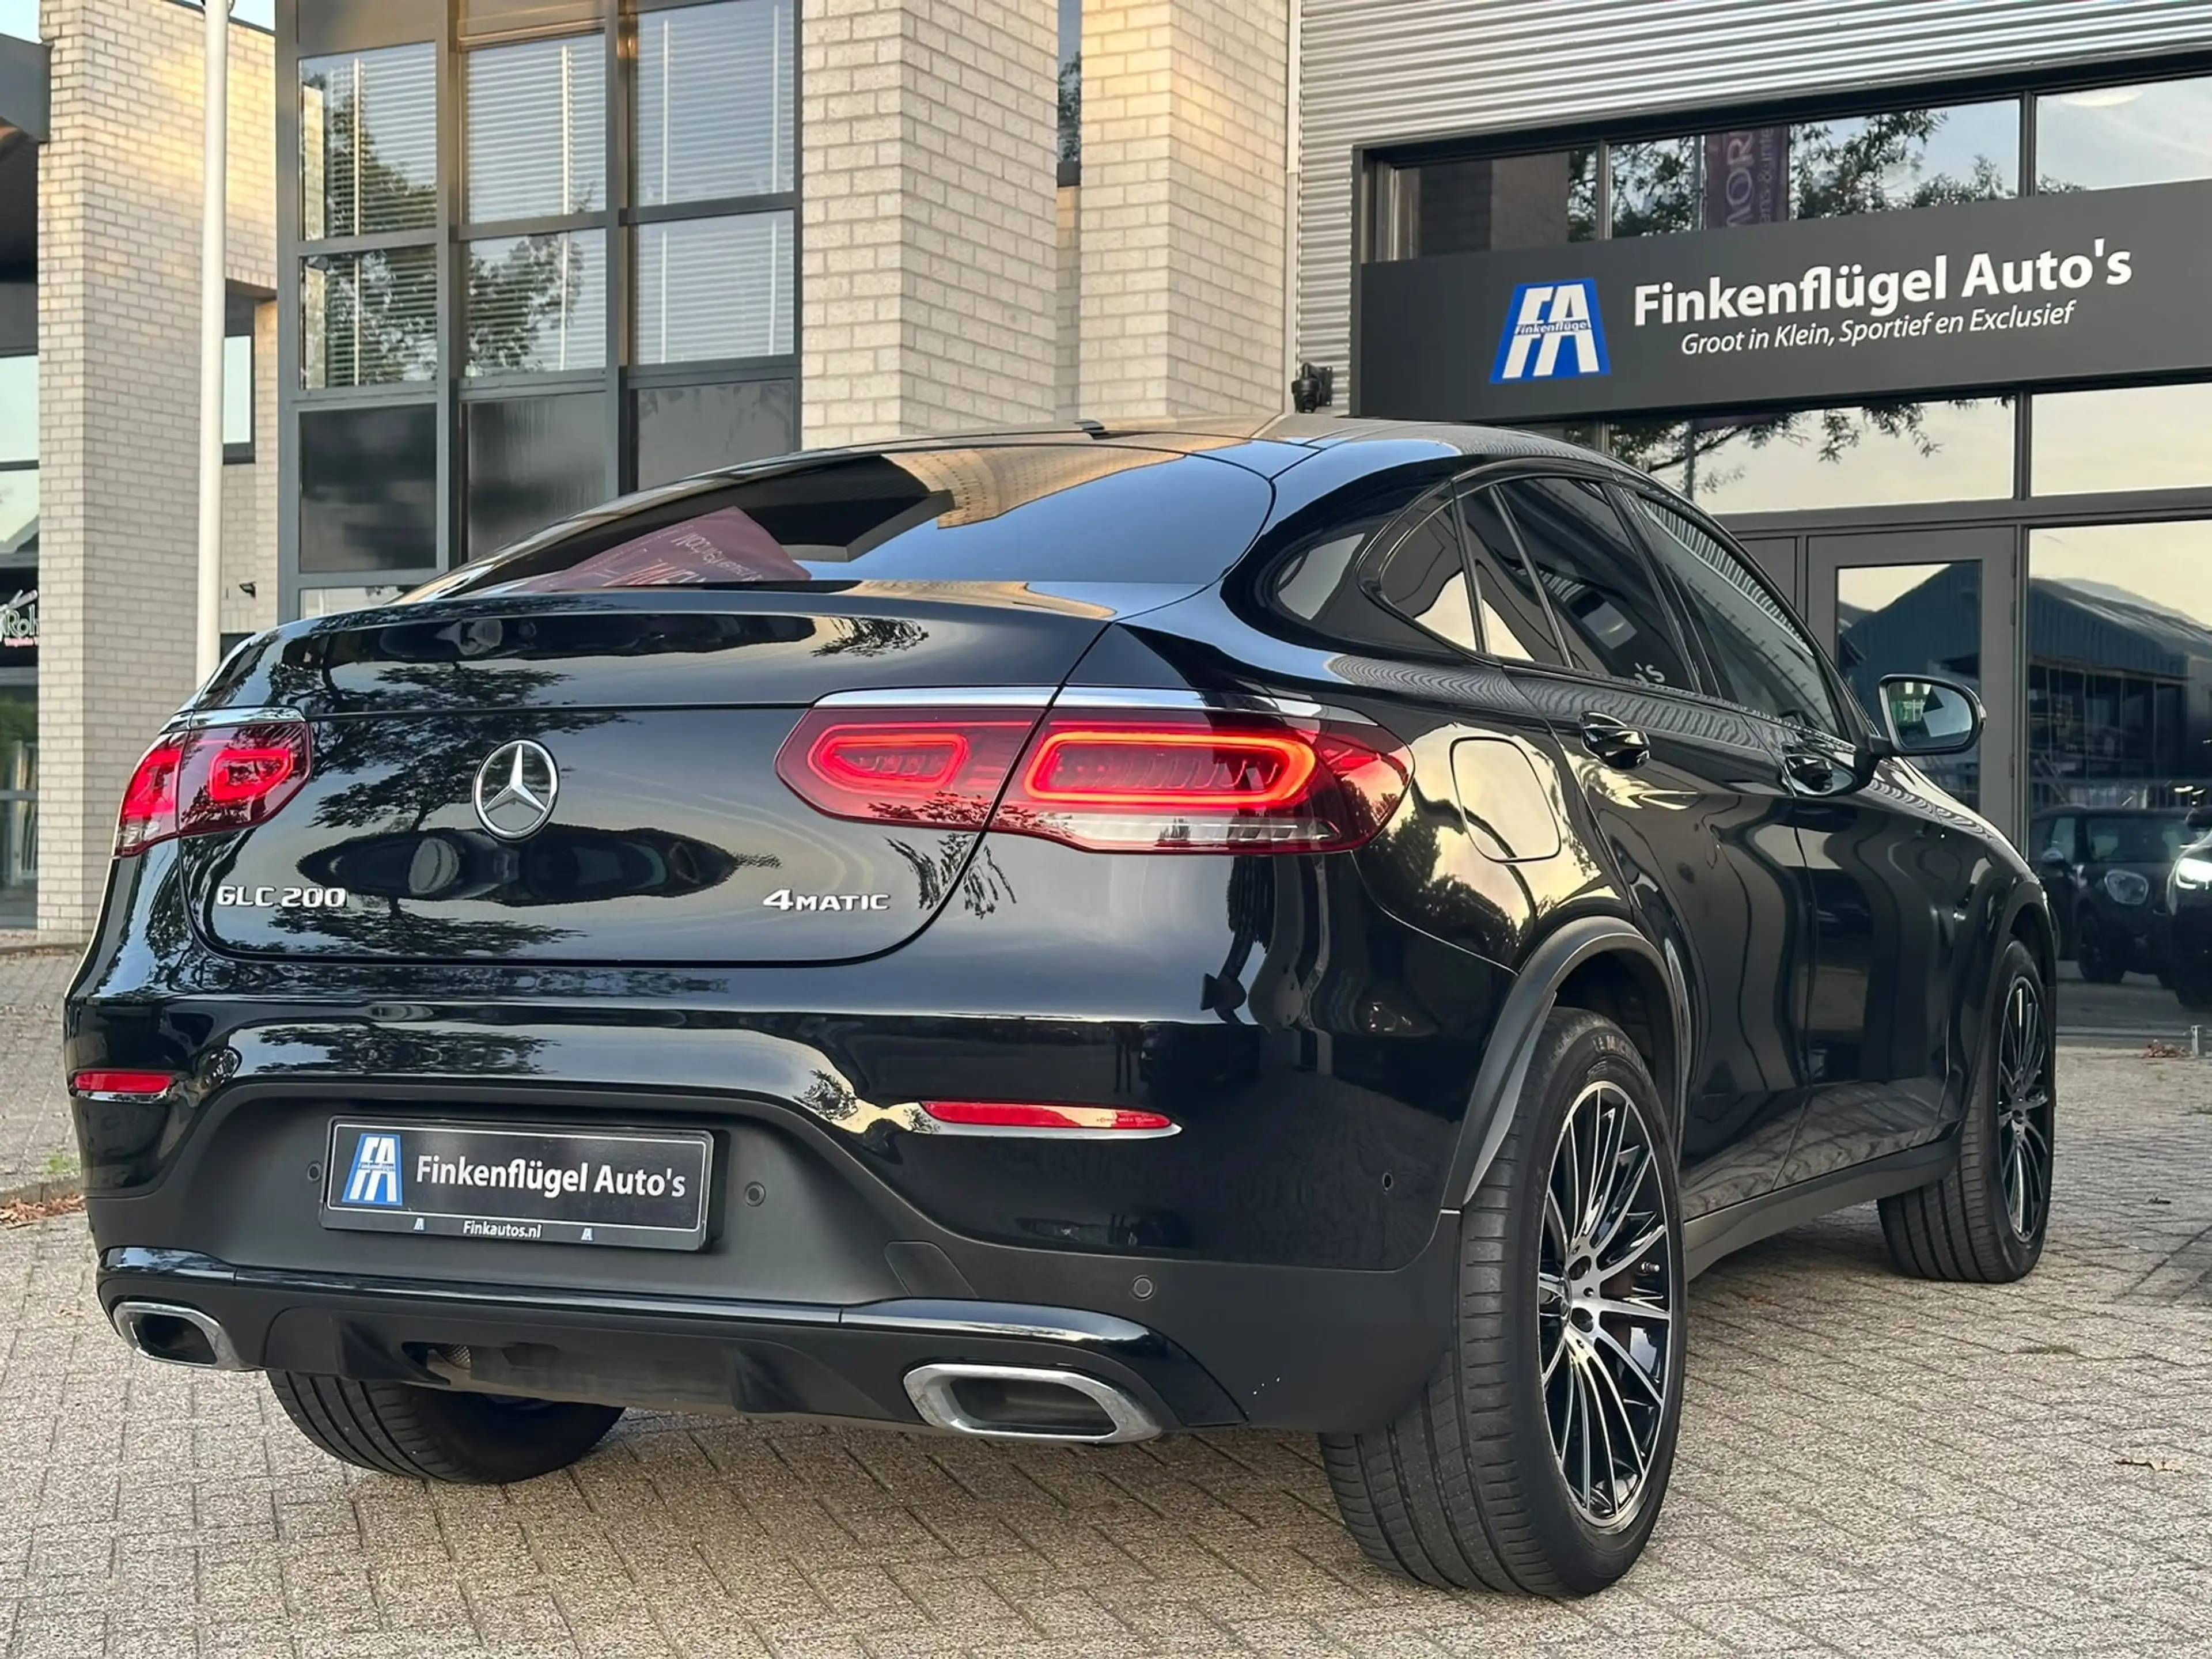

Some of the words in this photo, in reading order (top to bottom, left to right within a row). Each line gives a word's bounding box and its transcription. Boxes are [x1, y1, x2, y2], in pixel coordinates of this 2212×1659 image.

[1635, 255, 1947, 326] Finkenflügel
[1961, 237, 2133, 298] Auto's
[1681, 328, 1744, 355] Groot
[1748, 327, 1769, 350] in
[1774, 322, 1835, 349] Klein,
[1839, 312, 1934, 346] Sportief
[1935, 315, 1963, 334] en
[1969, 299, 2077, 332] Exclusief
[217, 885, 276, 907] GLC
[281, 887, 346, 908] 200
[763, 889, 889, 911] 4MATIC
[416, 1154, 588, 1198] Finkenflügel
[593, 1164, 686, 1198] Auto's
[463, 1219, 543, 1239] Finkautos.nl
